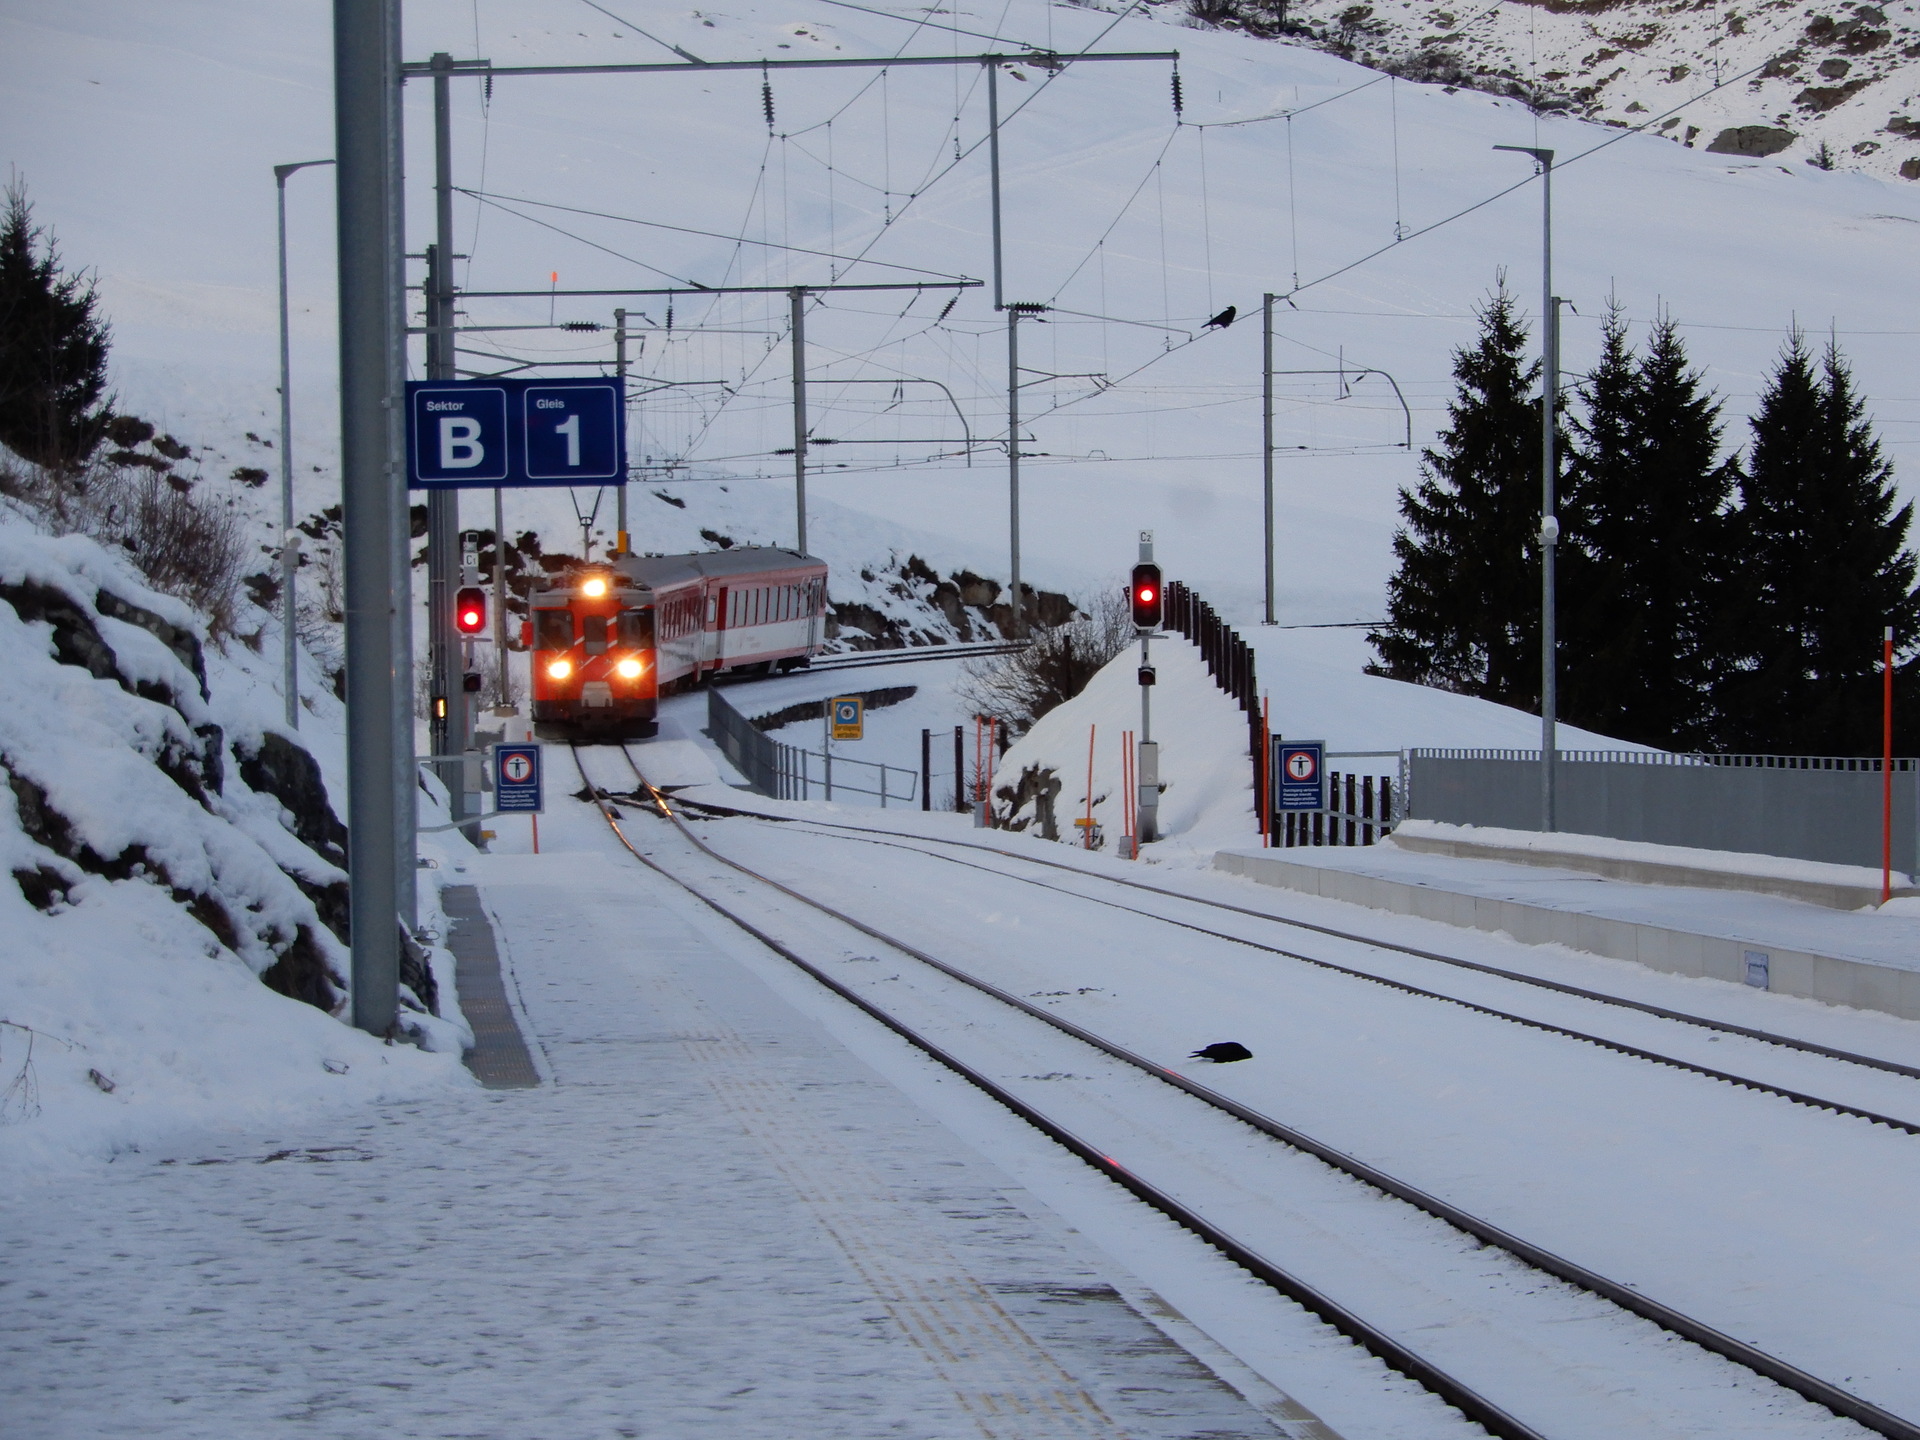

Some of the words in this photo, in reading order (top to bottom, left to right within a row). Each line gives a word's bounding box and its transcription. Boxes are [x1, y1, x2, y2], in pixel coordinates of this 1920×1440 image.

[426, 401, 464, 412] Sektor
[536, 399, 565, 409] Gleis
[439, 416, 485, 469] B
[555, 414, 581, 467] 1
[1140, 531, 1152, 542] C2
